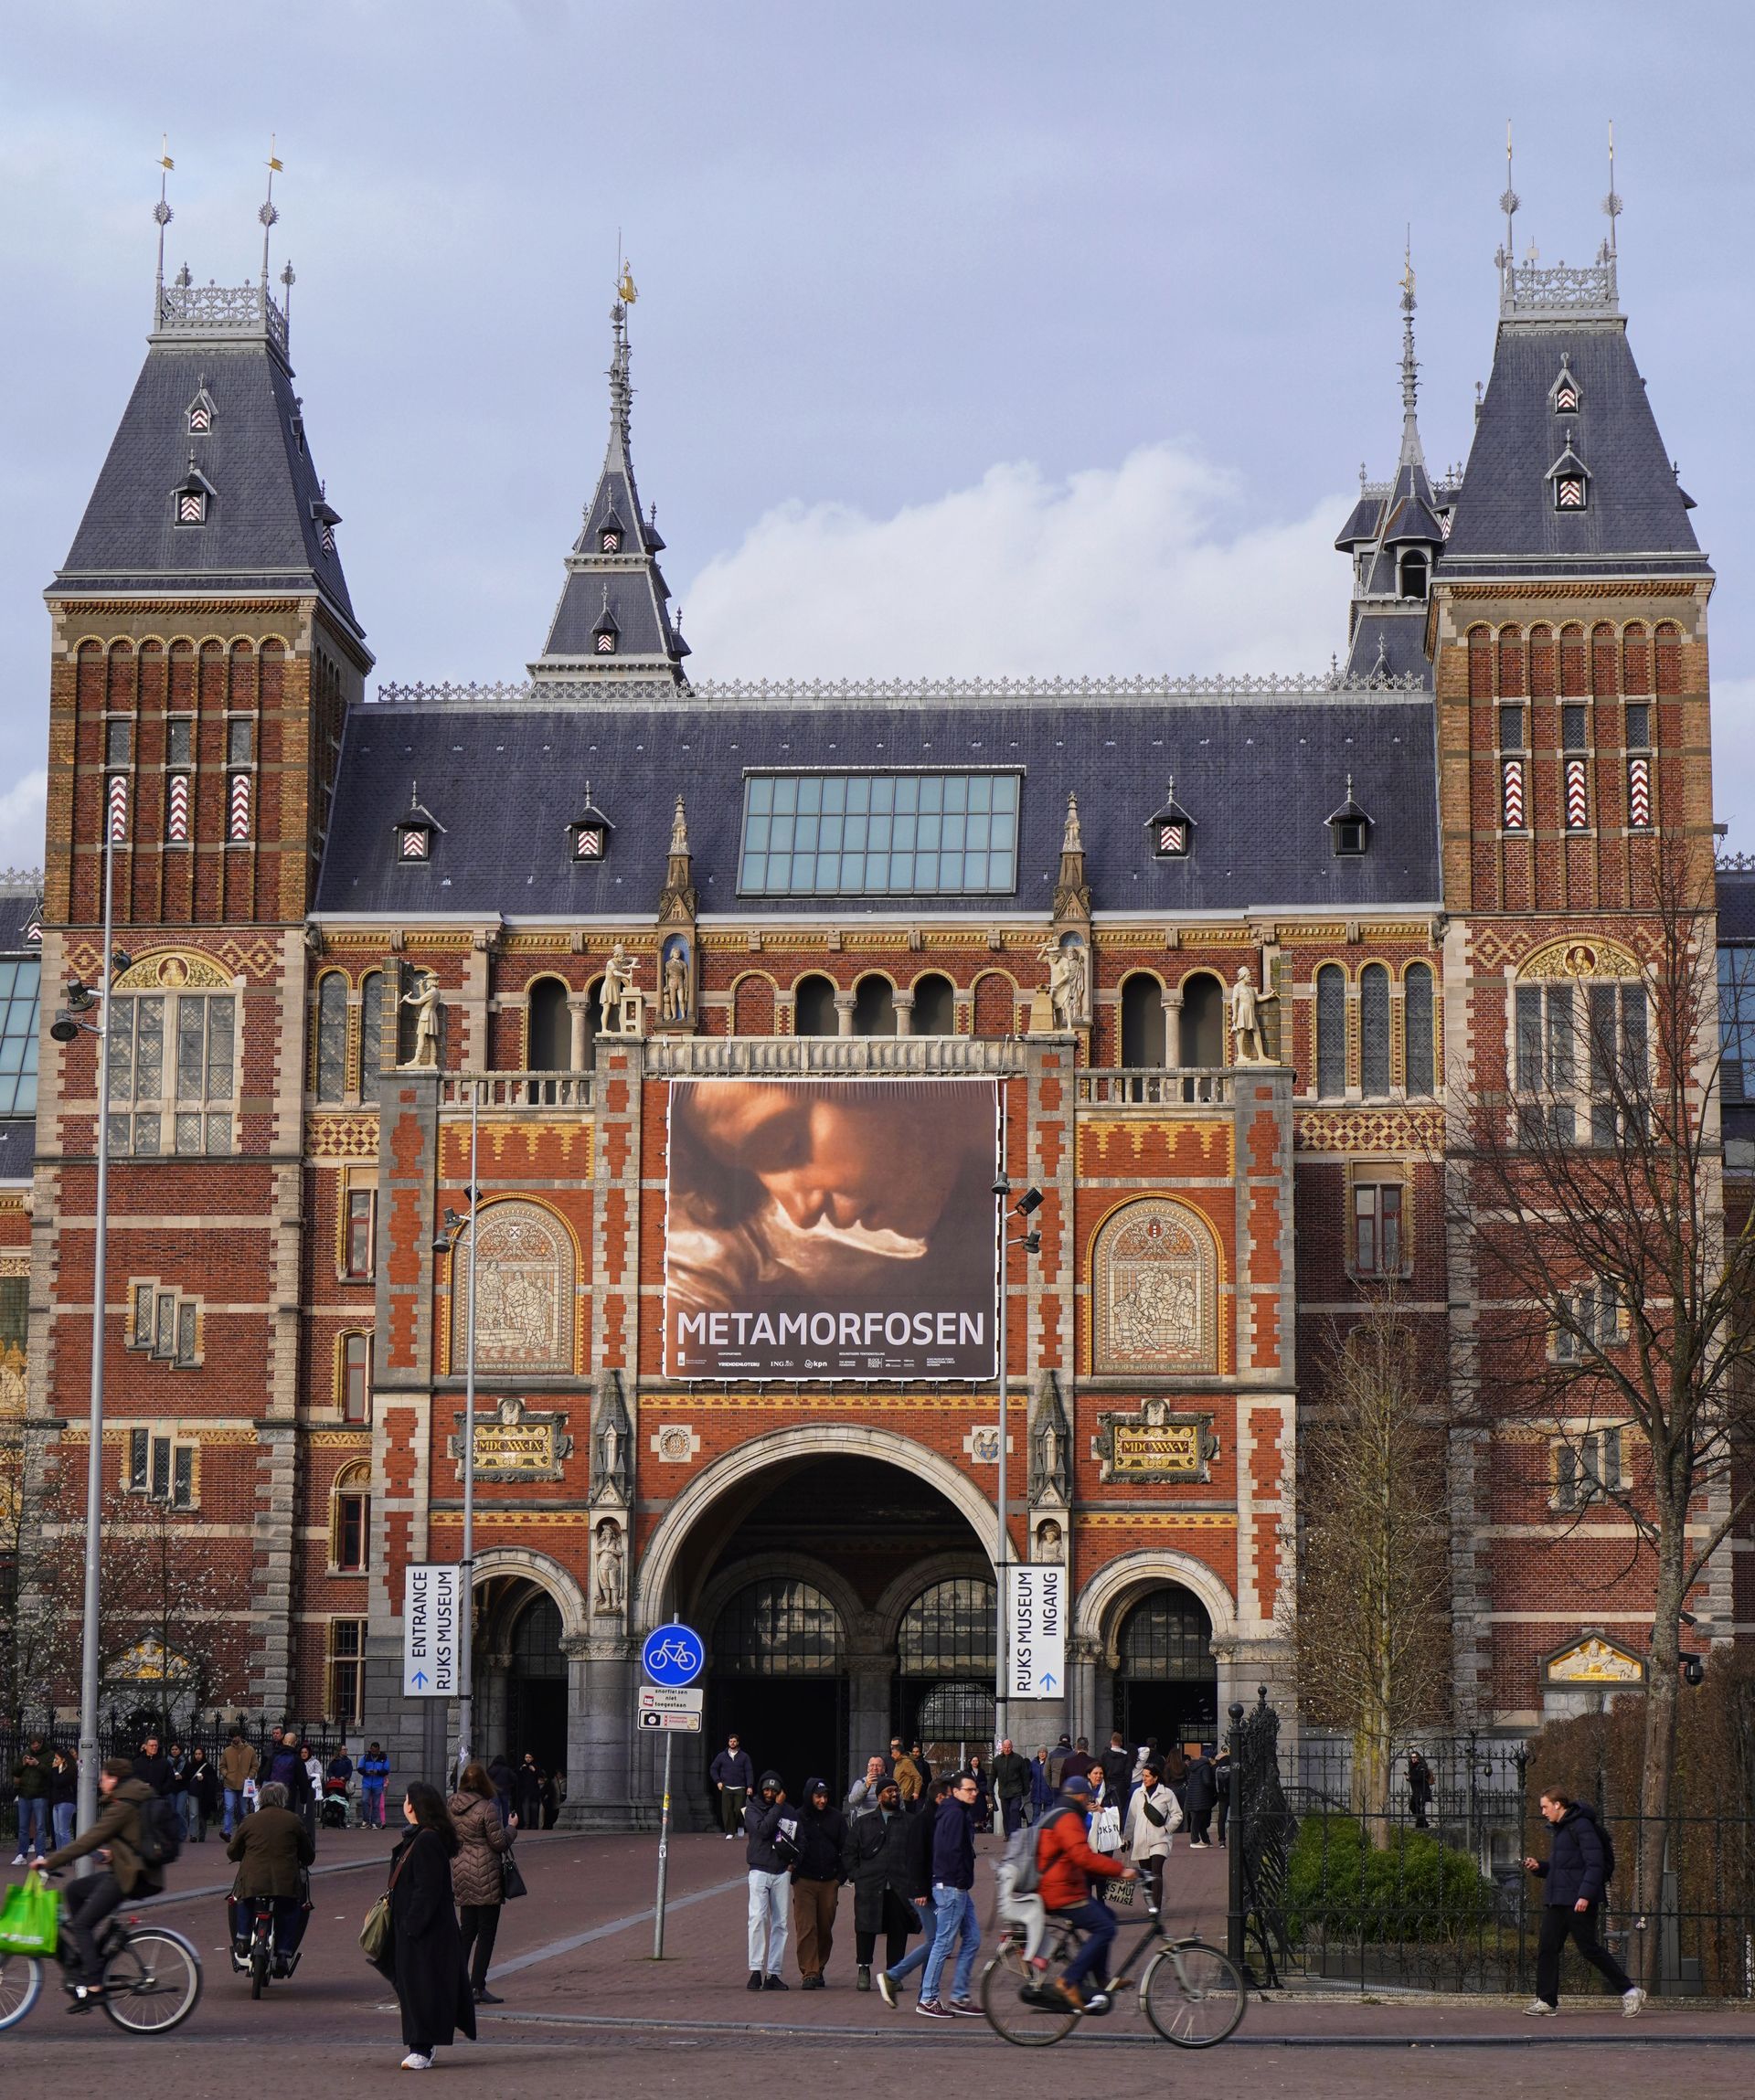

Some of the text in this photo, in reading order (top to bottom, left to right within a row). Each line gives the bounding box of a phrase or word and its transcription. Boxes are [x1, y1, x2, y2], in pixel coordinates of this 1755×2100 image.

[677, 1311, 984, 1345] METAMORFOSEN
[813, 1360, 828, 1368] kpn
[411, 1572, 427, 1658] ENTRANCE
[437, 1571, 452, 1690] RIJKS MUSEUM
[1016, 1572, 1032, 1692] RIJKS MUSEUM
[1043, 1573, 1058, 1636] INGANG
